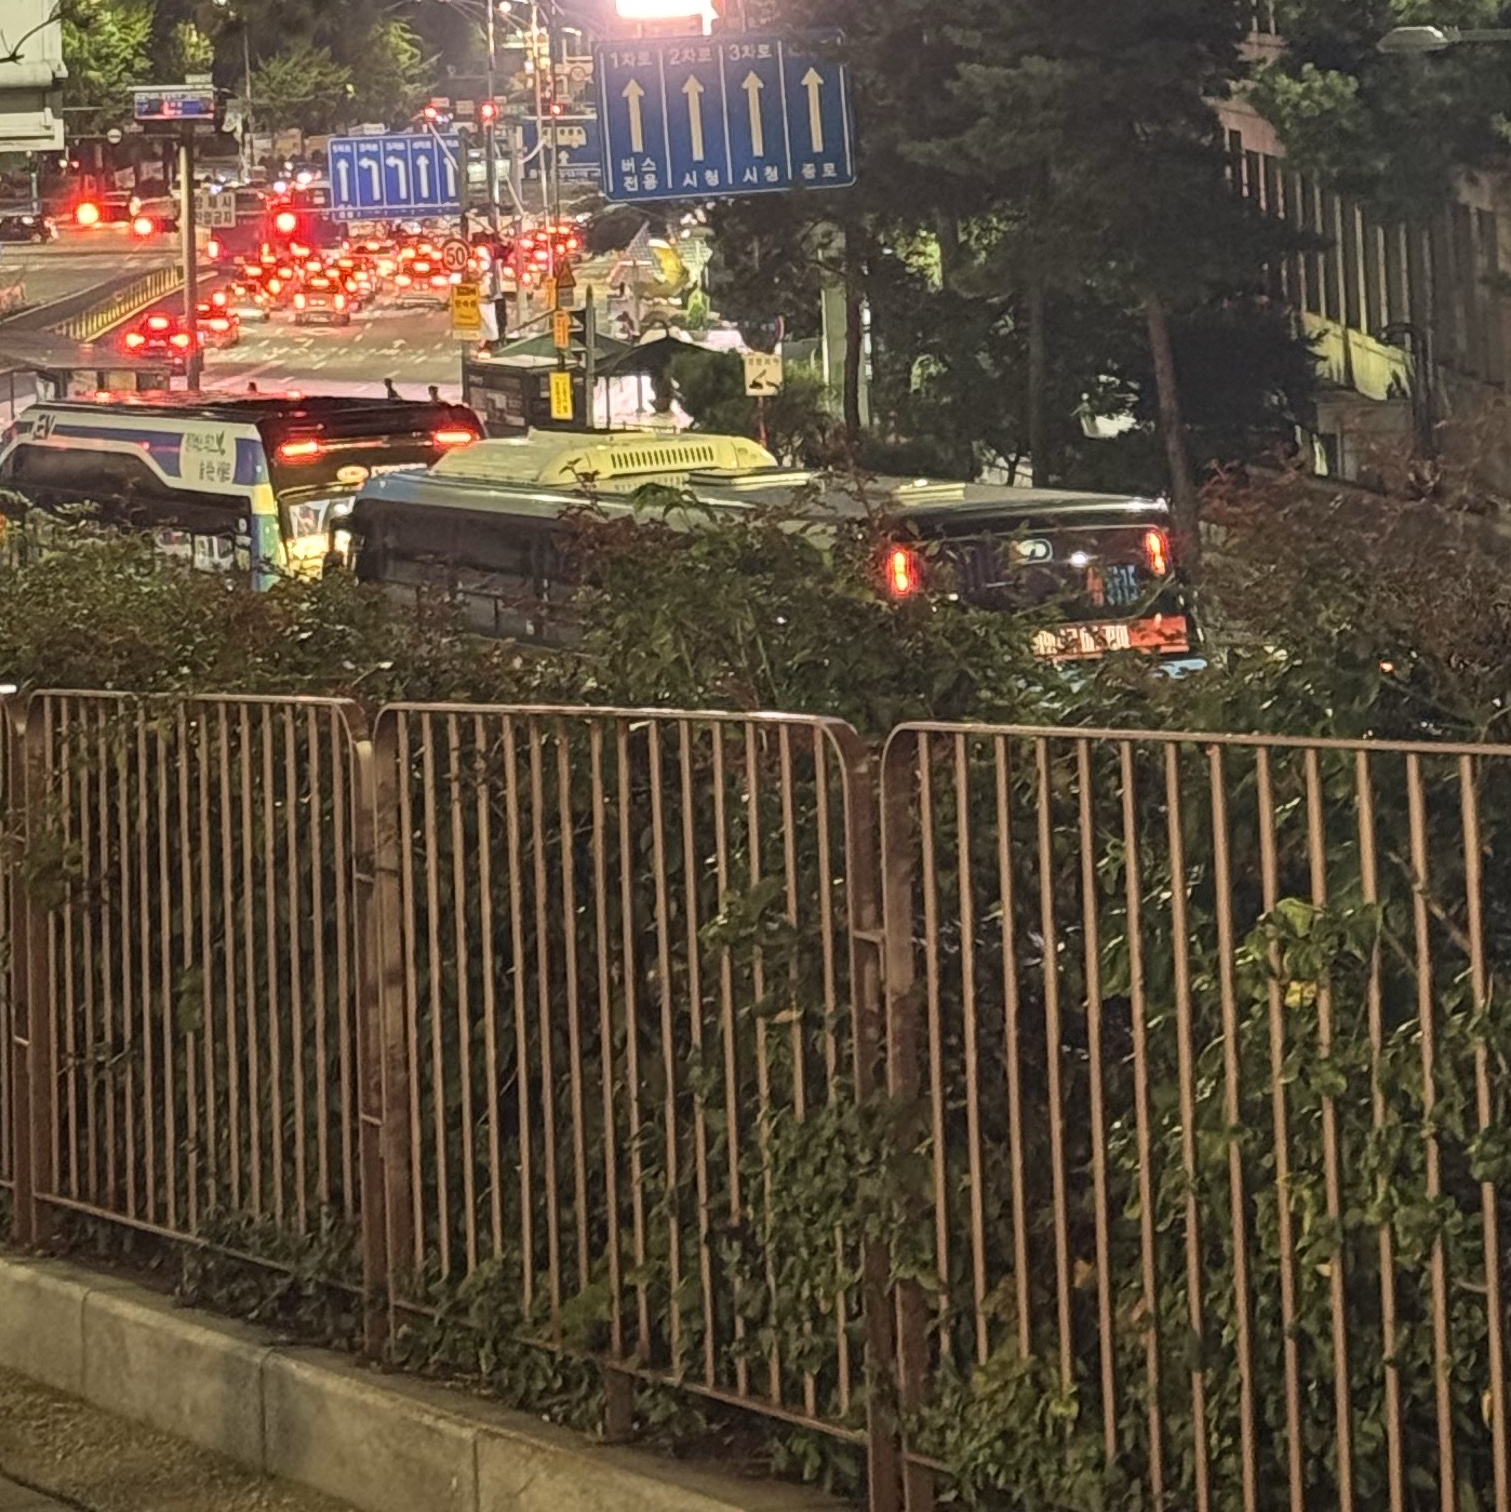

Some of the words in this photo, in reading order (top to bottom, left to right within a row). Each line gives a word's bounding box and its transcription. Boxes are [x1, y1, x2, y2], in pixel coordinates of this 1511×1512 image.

[610, 51, 653, 69] 1차로
[669, 47, 713, 66] 2차로
[728, 43, 774, 62] 3차로
[621, 156, 657, 173] 버스
[801, 162, 838, 180] 종로
[623, 173, 659, 191] 전용
[682, 169, 720, 187] 시청
[742, 165, 779, 184] 시청
[446, 246, 466, 266] 50
